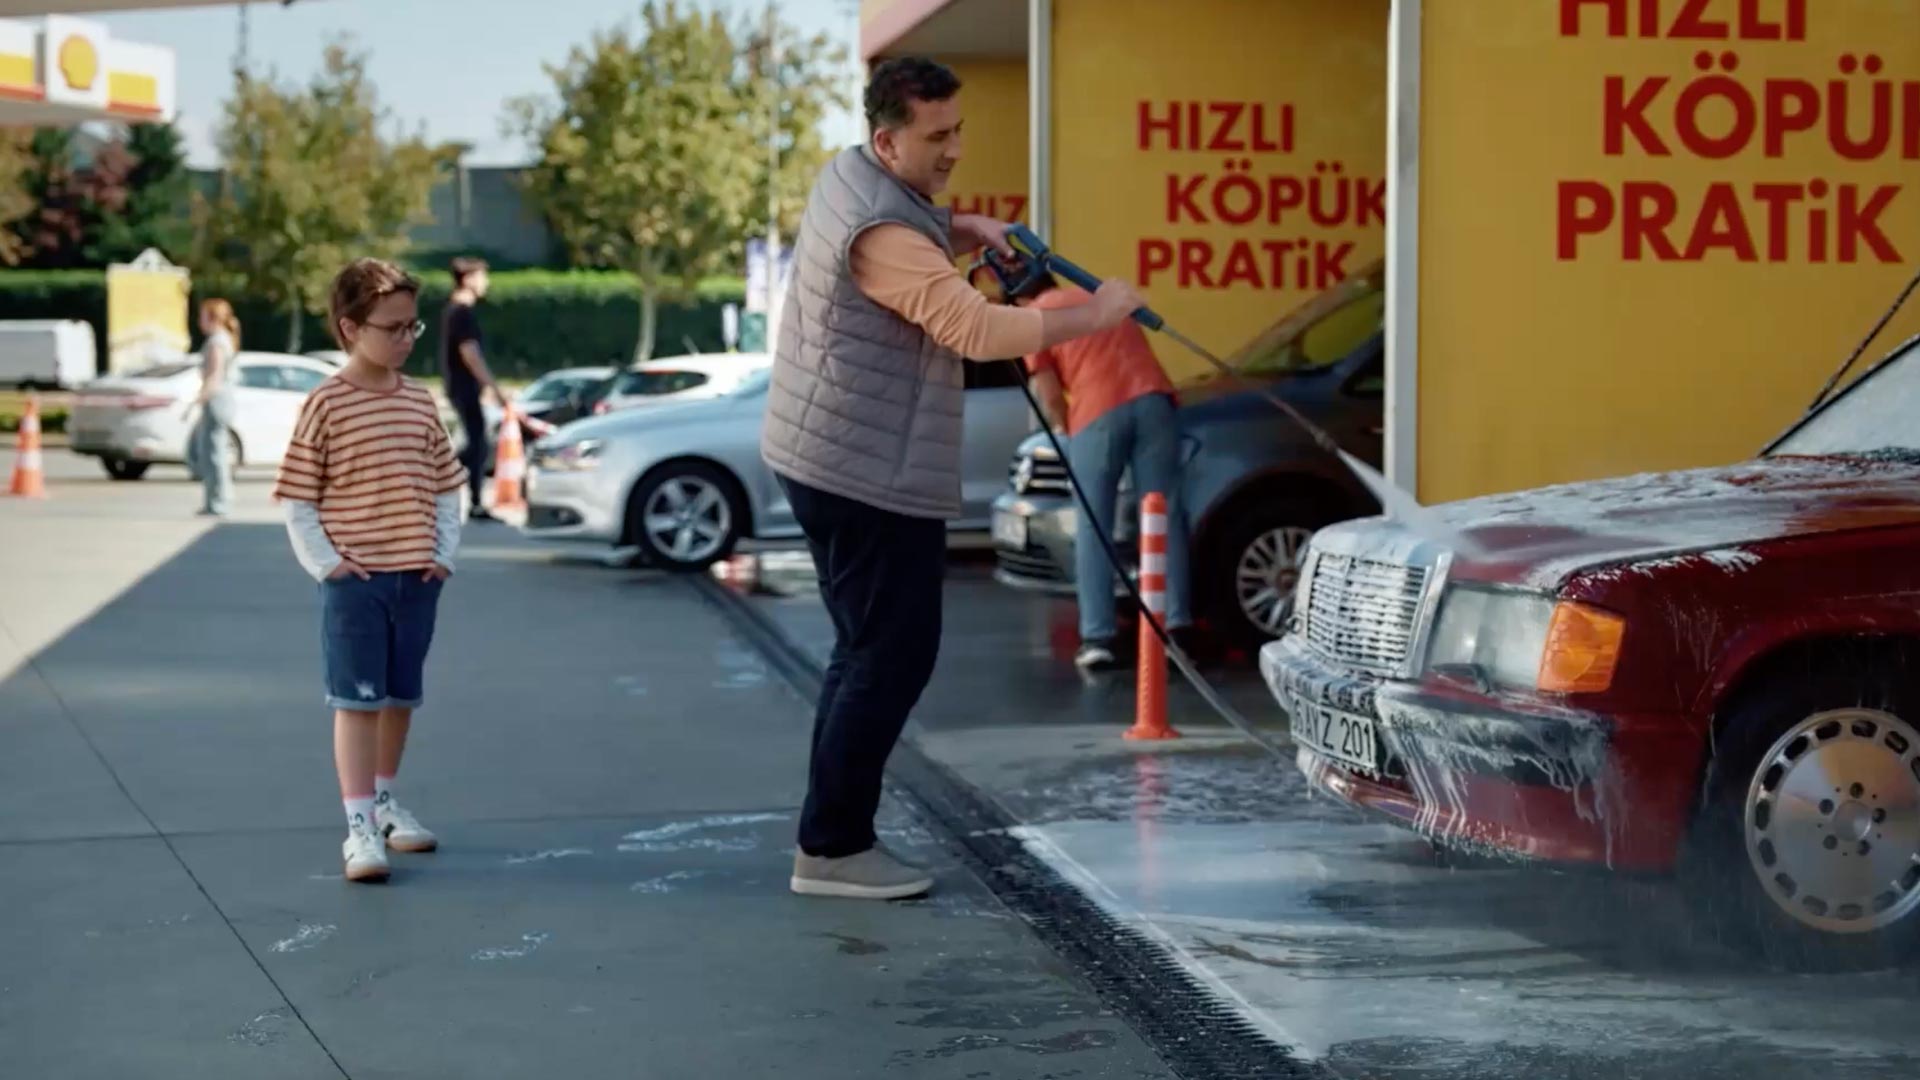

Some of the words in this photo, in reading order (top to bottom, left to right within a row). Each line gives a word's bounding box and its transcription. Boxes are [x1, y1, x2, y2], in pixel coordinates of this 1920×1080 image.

[1137, 101, 1295, 153] HIZLI
[1603, 50, 1920, 162] KÖPÜ
[1340, 717, 1372, 763] 201
